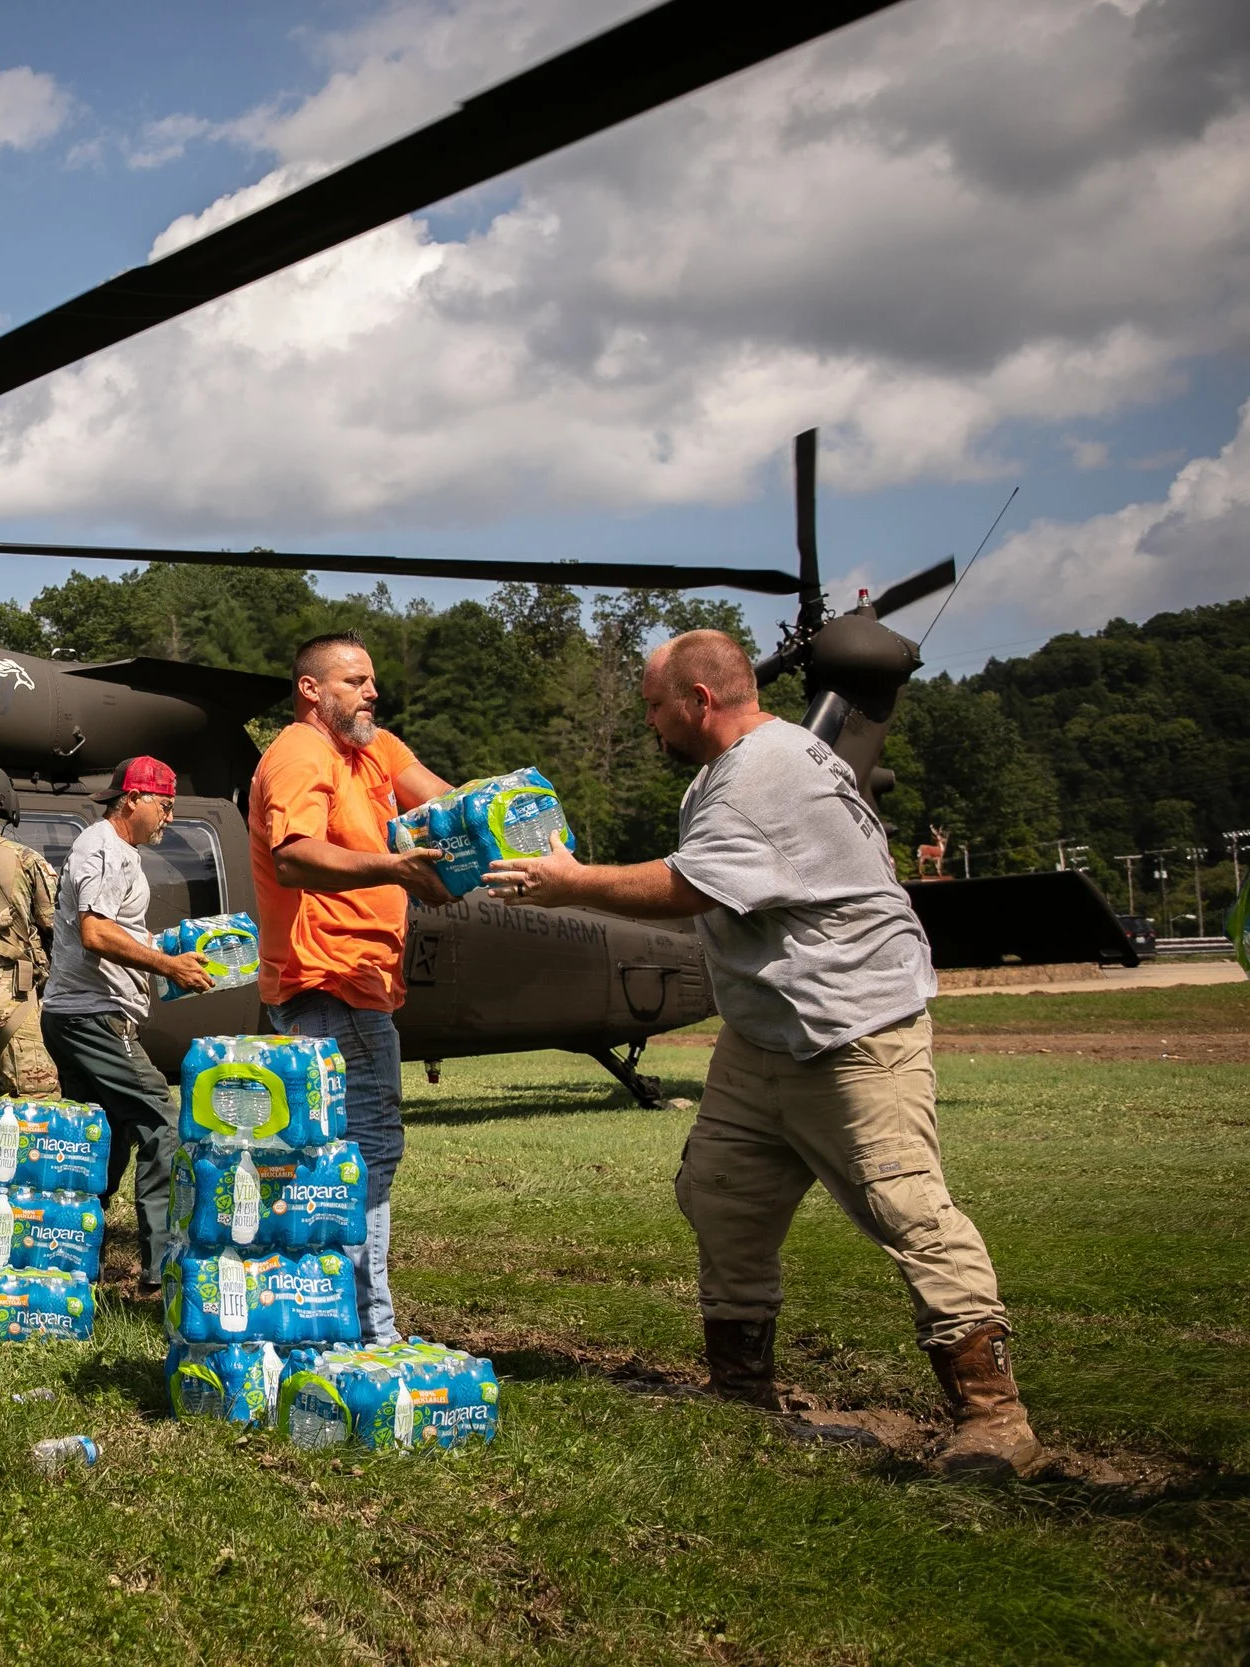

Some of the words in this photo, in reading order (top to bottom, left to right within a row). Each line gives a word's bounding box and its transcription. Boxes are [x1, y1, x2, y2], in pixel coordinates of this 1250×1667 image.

[478, 901, 550, 937] STATES
[556, 917, 608, 947] ARMY
[4, 1148, 15, 1158] ESTA
[36, 1137, 91, 1154] niagara
[260, 1171, 294, 1179] RECICLABLES
[344, 1167, 356, 1175] 24
[236, 1183, 259, 1200] VIDA
[282, 1184, 348, 1201] niagara
[237, 1201, 242, 1214] A
[244, 1202, 258, 1215] ESTA
[84, 1216, 94, 1225] 24
[234, 1214, 258, 1227] BOTELLA
[31, 1225, 84, 1243] niagara
[324, 1258, 336, 1267] 24
[222, 1266, 244, 1282] BOTTLE
[268, 1274, 333, 1293] niagara
[223, 1293, 245, 1317] LIFE
[16, 1310, 73, 1328] niagara
[486, 1387, 496, 1395] 24
[432, 1404, 488, 1426] niagara
